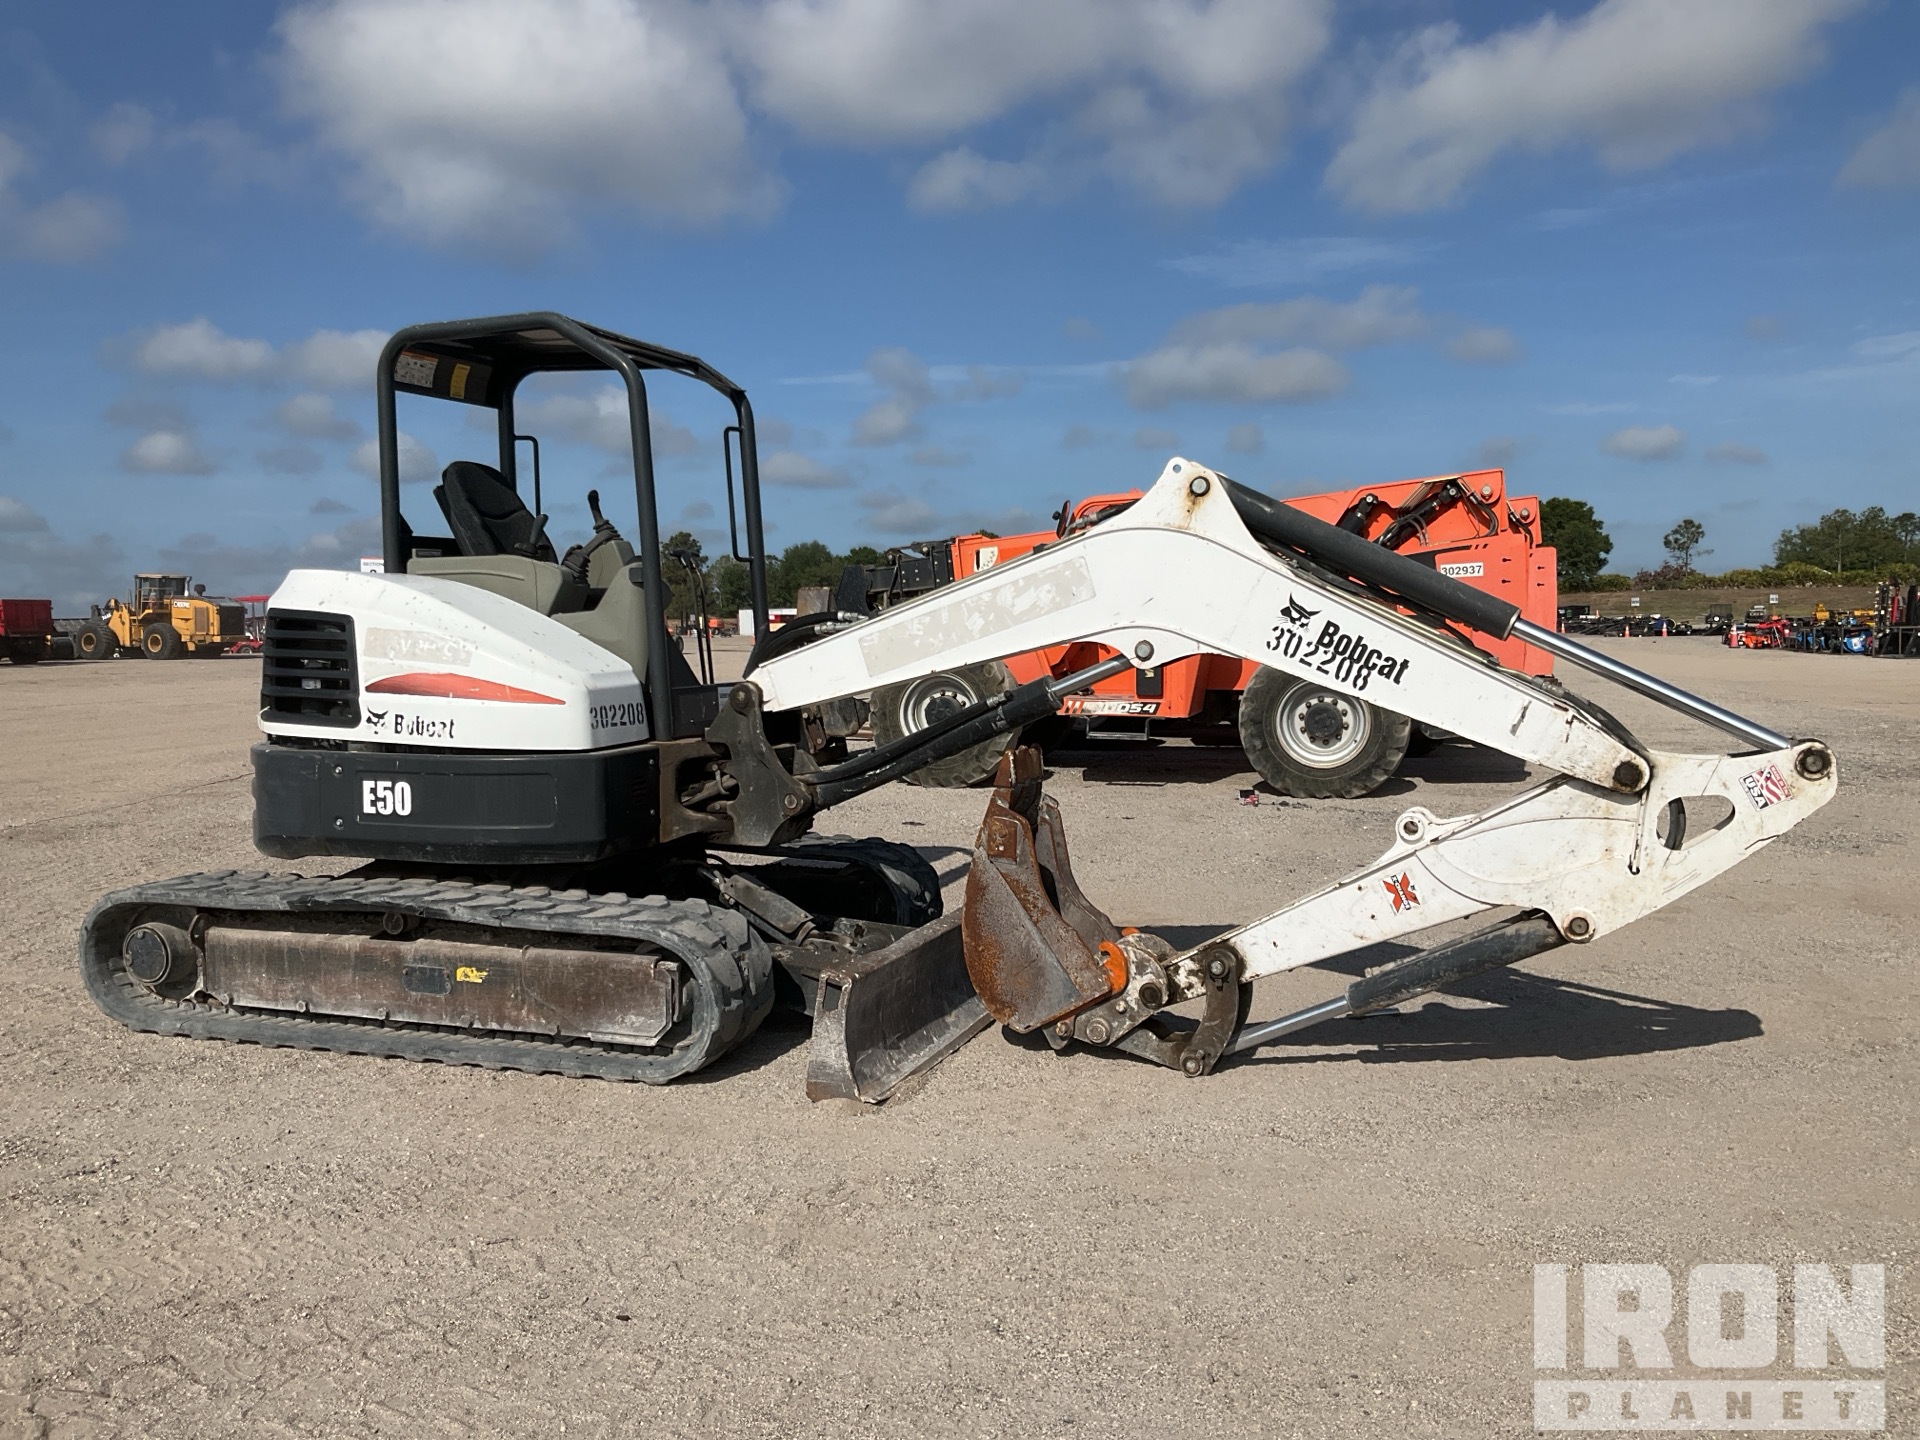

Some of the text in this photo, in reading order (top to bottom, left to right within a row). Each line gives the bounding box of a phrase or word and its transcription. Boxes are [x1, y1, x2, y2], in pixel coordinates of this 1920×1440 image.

[1441, 564, 1483, 576] 302937
[173, 601, 190, 609] DEERE
[1266, 625, 1372, 691] 302208
[1316, 619, 1410, 686] Bobcat
[590, 702, 645, 730] 302208
[362, 780, 412, 816] E50
[1744, 776, 1768, 809] USA
